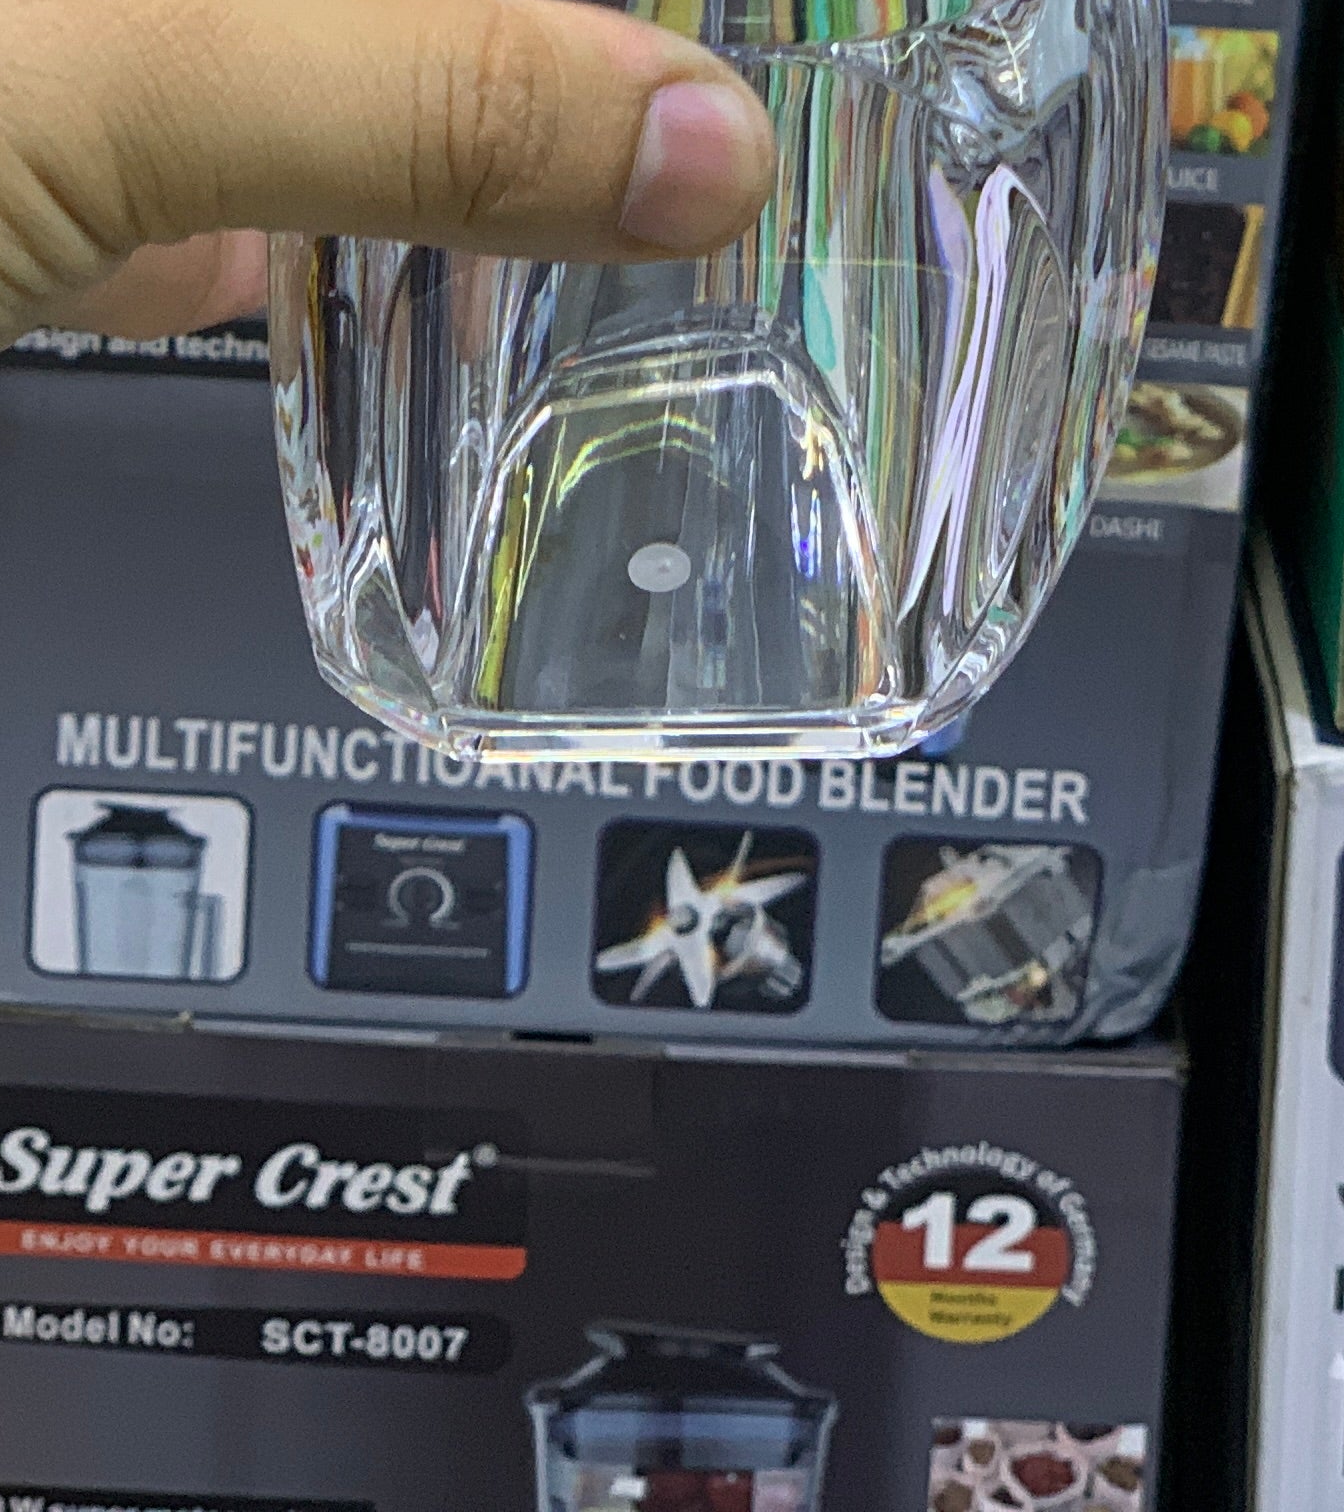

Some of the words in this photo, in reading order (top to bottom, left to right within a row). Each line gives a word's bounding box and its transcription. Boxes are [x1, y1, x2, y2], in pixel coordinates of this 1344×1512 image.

[1168, 167, 1219, 192] UICE
[13, 327, 101, 360] esign
[107, 336, 168, 358] and
[645, 760, 803, 810] FOOD
[820, 761, 1092, 825] BLENDER
[255, 1142, 473, 1217] Crest
[877, 1139, 1039, 1190] Technology
[20, 1230, 113, 1253] ENJOY
[123, 1235, 198, 1259] YOUR
[208, 1239, 354, 1268] EVERYDAY
[364, 1248, 426, 1271] LIFE
[902, 1191, 1039, 1273] 12
[2, 1304, 121, 1345] Model
[127, 1313, 196, 1350] No:
[260, 1317, 470, 1362] SCT-8007
